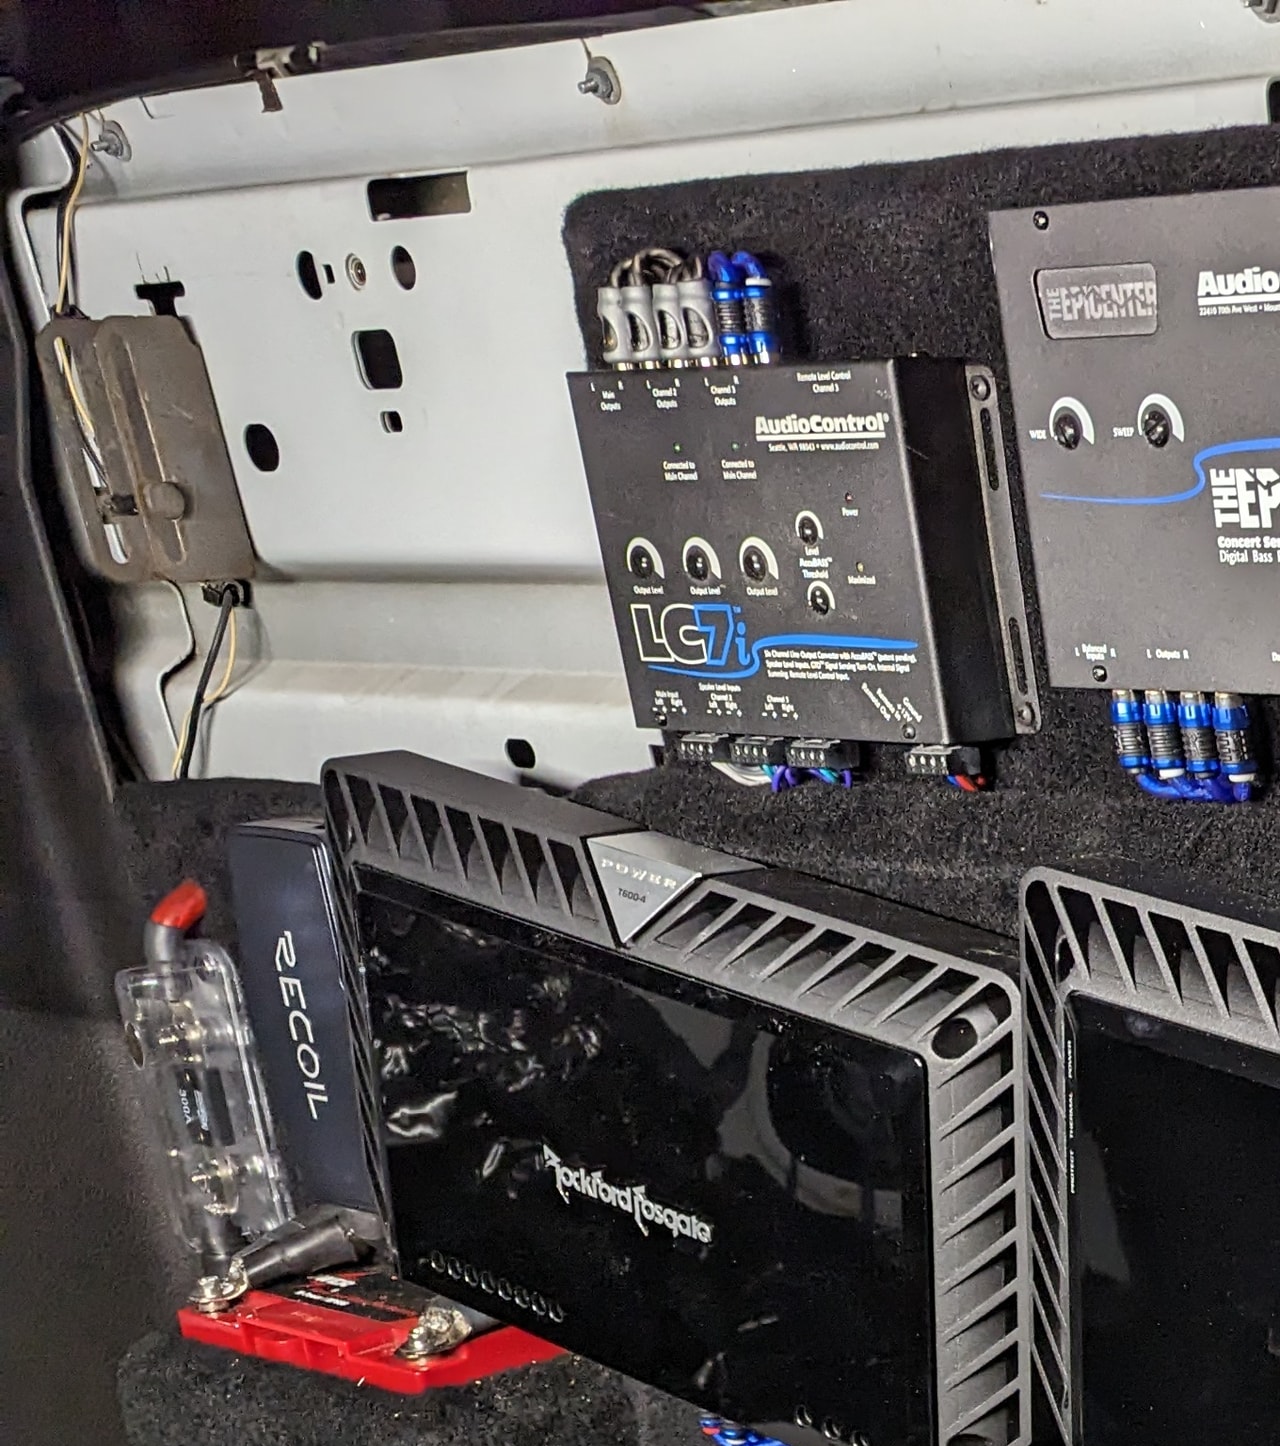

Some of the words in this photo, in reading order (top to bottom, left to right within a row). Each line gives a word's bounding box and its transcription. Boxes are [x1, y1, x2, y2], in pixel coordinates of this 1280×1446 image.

[1046, 287, 1062, 321] THE
[1060, 281, 1156, 321] EPICENTER
[797, 372, 817, 382] Remote
[817, 371, 831, 381] Level
[831, 370, 852, 380] Control
[812, 383, 834, 393] Channel
[602, 390, 615, 399] Main
[600, 402, 622, 411] Outputs
[656, 399, 678, 409] Outputs
[714, 396, 737, 406] Outputs
[755, 412, 885, 434] AudioControl
[1029, 429, 1047, 440] WIDE
[1113, 427, 1134, 438] SWEEP
[663, 460, 689, 470] Connected
[721, 459, 747, 469] Connected
[1209, 468, 1240, 528] THE
[841, 507, 859, 517] Power
[1217, 535, 1262, 549] Concert
[804, 546, 820, 556] Level
[1219, 550, 1249, 566] Digital
[1252, 551, 1273, 564] Bass
[802, 569, 829, 579] Threshold
[633, 586, 651, 596] Output
[650, 586, 664, 595] Level
[690, 586, 707, 596] Output
[707, 587, 721, 595] Level
[746, 587, 764, 596] Output
[764, 587, 779, 596] Level
[630, 603, 750, 666] LC7i
[1155, 649, 1181, 660] Outputs
[601, 858, 677, 889] POWER
[618, 887, 647, 903] T600-4
[275, 930, 328, 1120] RECOIL
[543, 1143, 633, 1214] Rockford
[631, 1184, 713, 1243] Fosgate
